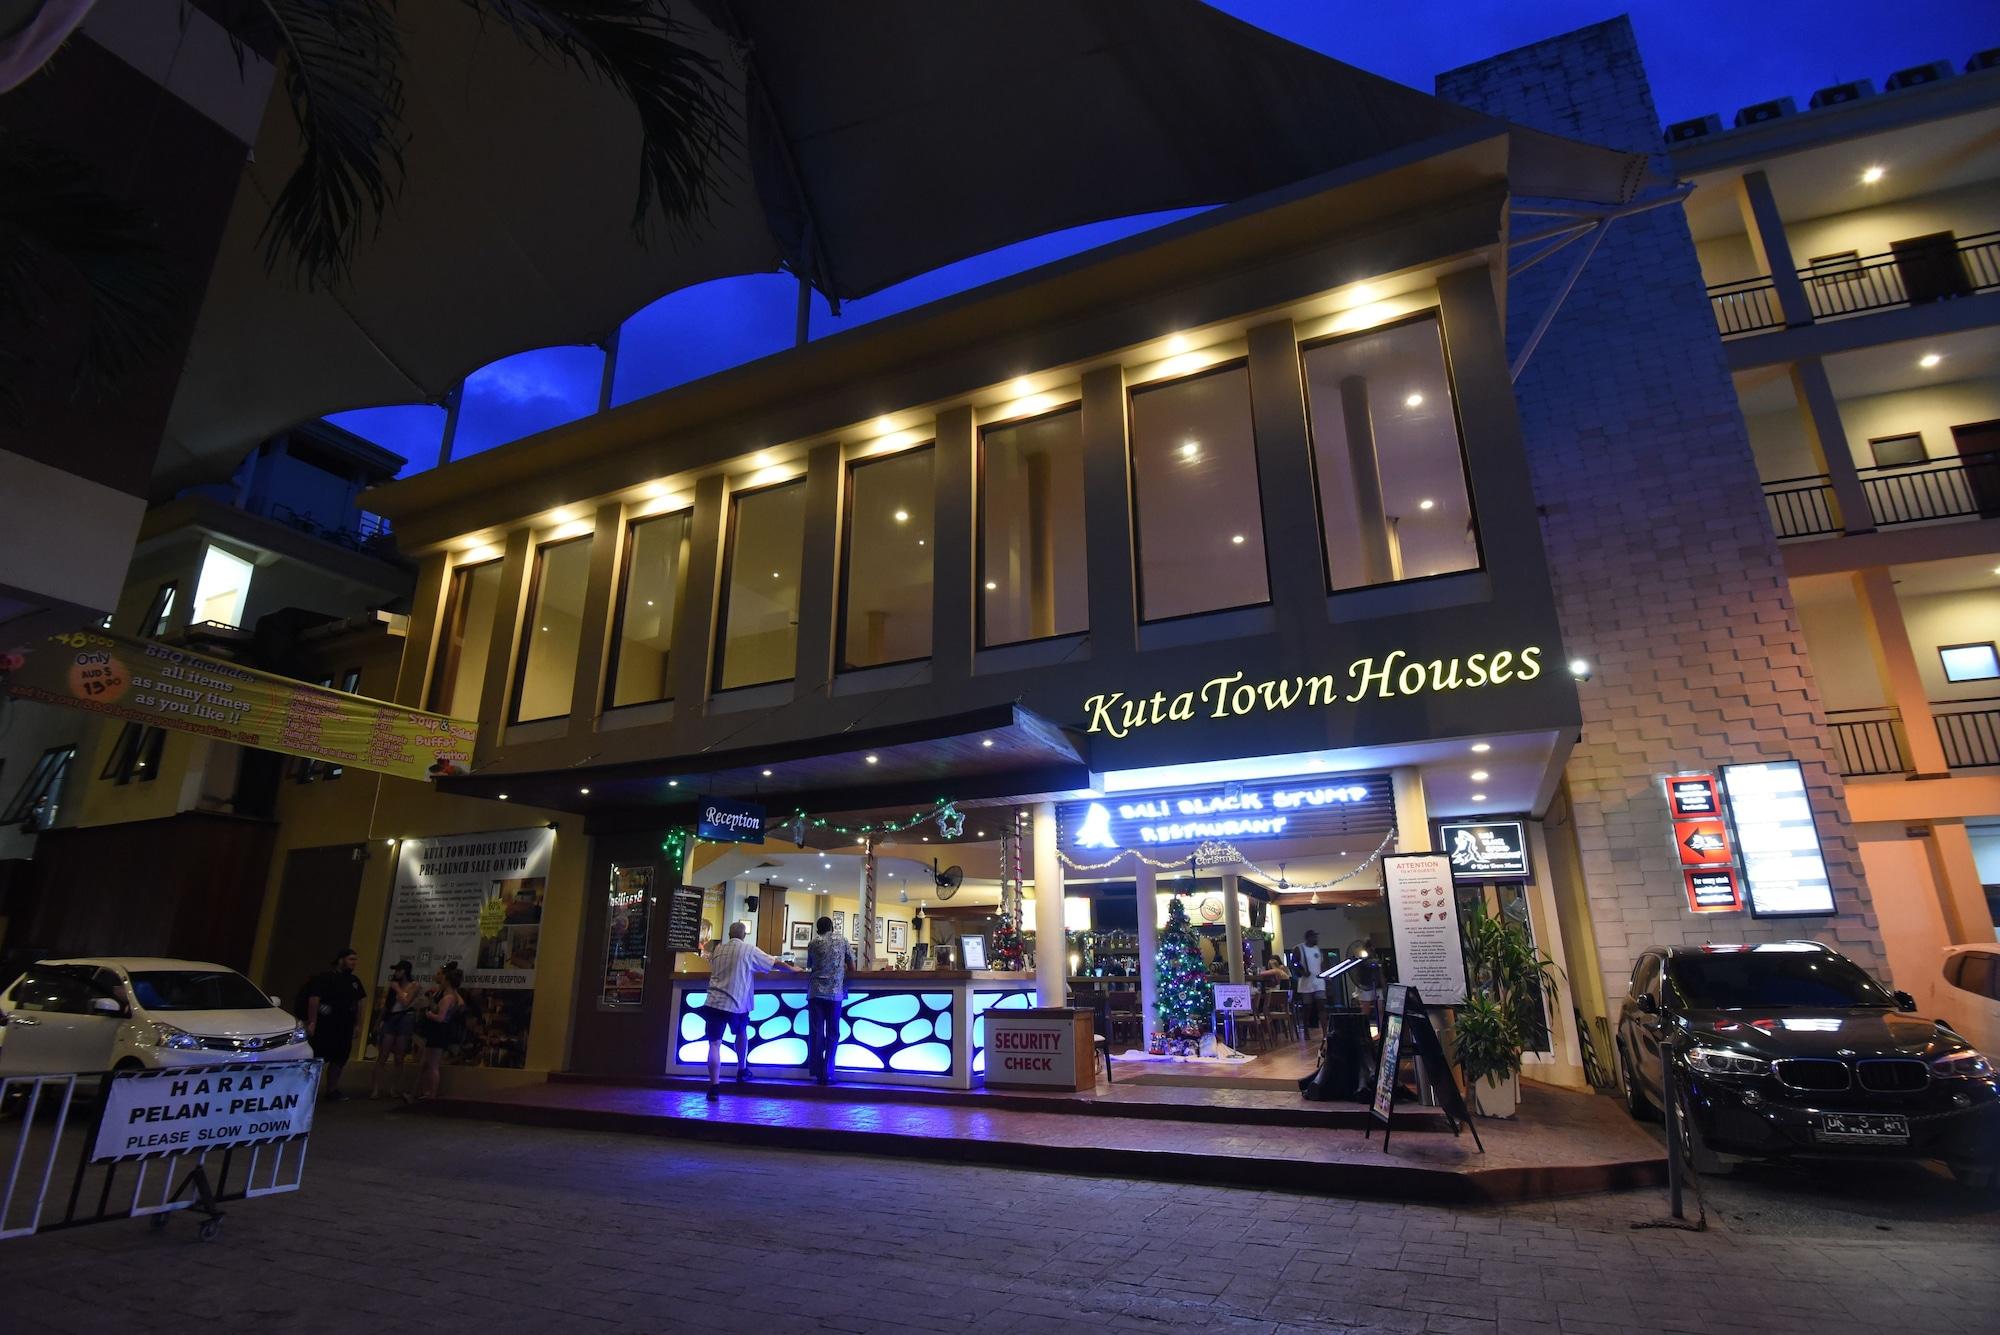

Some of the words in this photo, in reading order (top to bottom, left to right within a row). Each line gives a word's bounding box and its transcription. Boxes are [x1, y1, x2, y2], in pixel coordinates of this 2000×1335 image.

[77, 652, 111, 666] Only
[145, 643, 184, 663] BBQ
[161, 665, 185, 680] all
[186, 671, 234, 692] items
[132, 676, 152, 689] as
[155, 681, 203, 703] many
[207, 692, 251, 712] times
[1084, 690, 1196, 739] Kuta
[1199, 670, 1338, 719] Town
[1345, 645, 1541, 703] Houses
[135, 693, 155, 706] as
[159, 698, 190, 714] you
[193, 704, 225, 721] like
[408, 713, 439, 733] Soup
[433, 749, 470, 761] Station
[1118, 800, 1171, 820] BALI
[1177, 792, 1264, 816] BLACK
[1272, 786, 1368, 809] STUMP
[706, 806, 760, 832] Reception
[1140, 817, 1287, 842] RESTAURANT
[419, 861, 469, 876] PRE-LAUNCH
[471, 859, 491, 873] SALE
[493, 859, 505, 872] ON
[507, 857, 528, 871] NOW
[1195, 855, 1242, 866] Christmas
[1396, 861, 1439, 870] ATTENTION
[995, 1032, 1061, 1050] SECURITY
[1004, 1057, 1052, 1071] CHECK
[170, 1074, 275, 1097] HARAP
[128, 1102, 210, 1124] PELAN
[229, 1094, 299, 1115] PELAN
[126, 1130, 190, 1149] PLEASE
[197, 1125, 243, 1141] SLOW
[248, 1119, 291, 1135] DOWN
